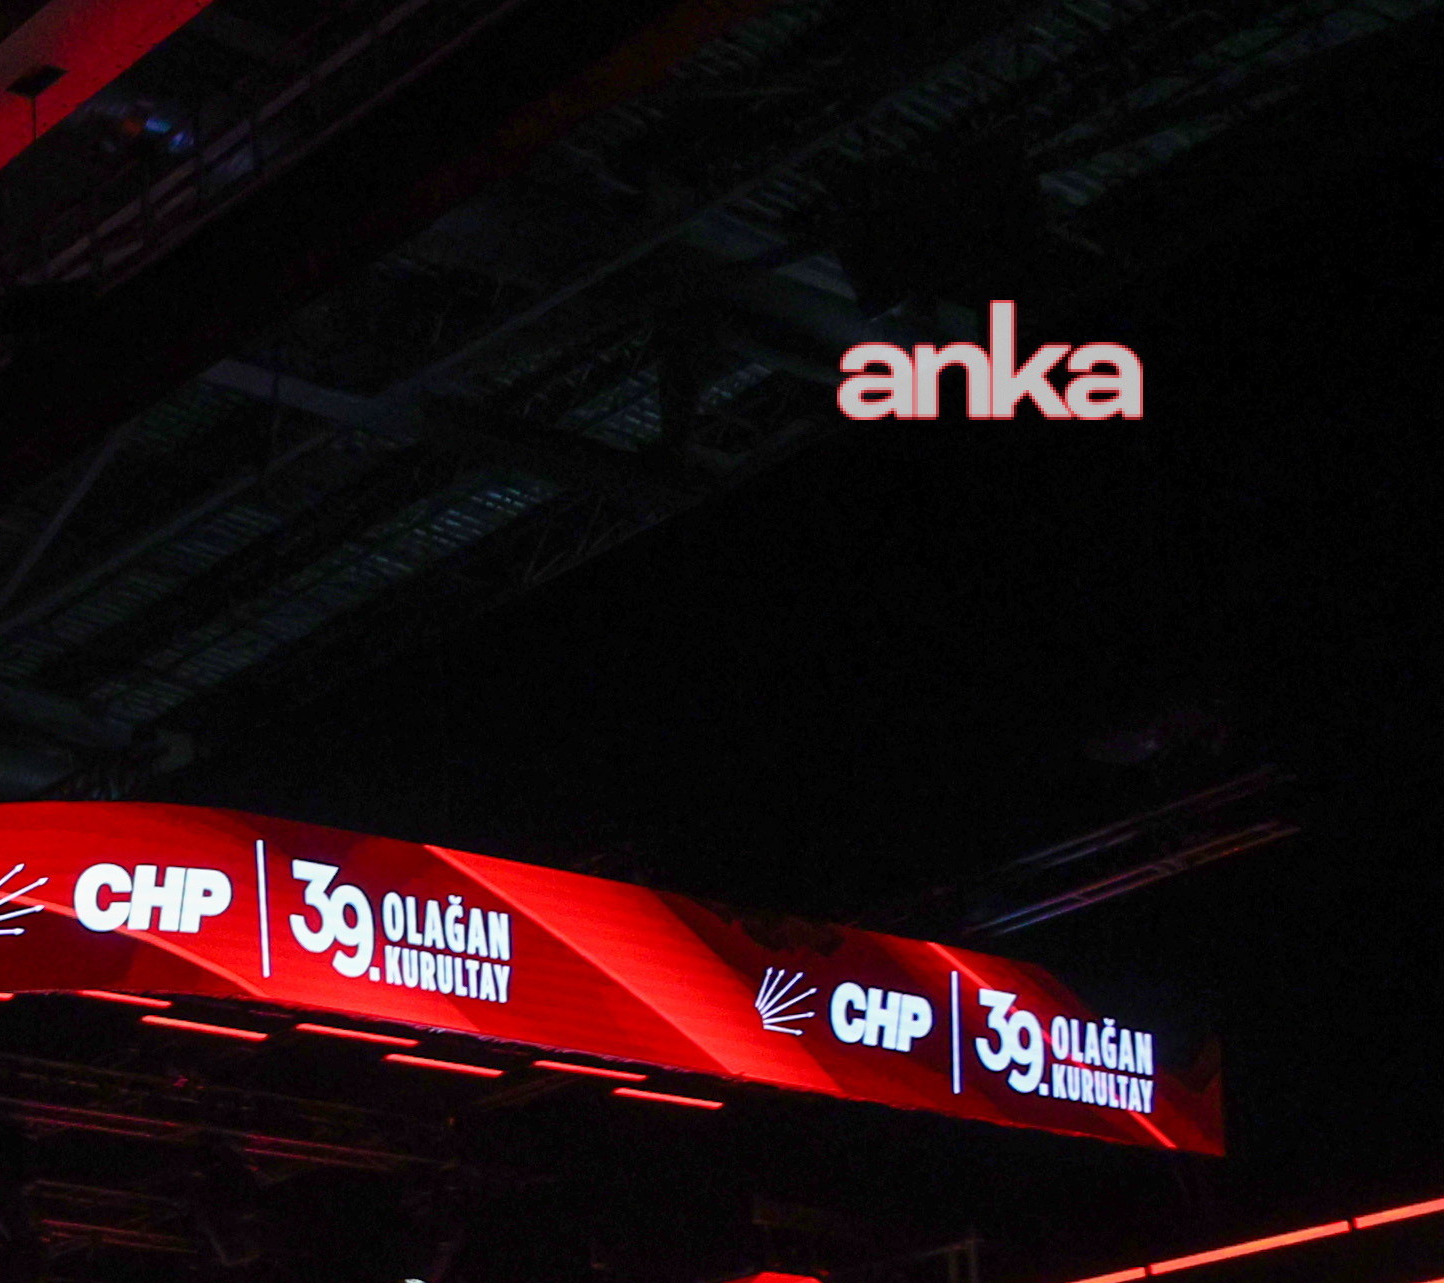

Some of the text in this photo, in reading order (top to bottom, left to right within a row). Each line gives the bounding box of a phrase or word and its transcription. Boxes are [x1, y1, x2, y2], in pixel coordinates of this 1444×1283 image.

[74, 862, 232, 932] CHP
[288, 859, 511, 982] 39. OLAĞAN
[383, 944, 511, 1004] KURULTAY
[830, 981, 933, 1053] CHP
[975, 988, 1154, 1096] 39. OLAĞAN
[1051, 1063, 1154, 1114] KURULTAY
